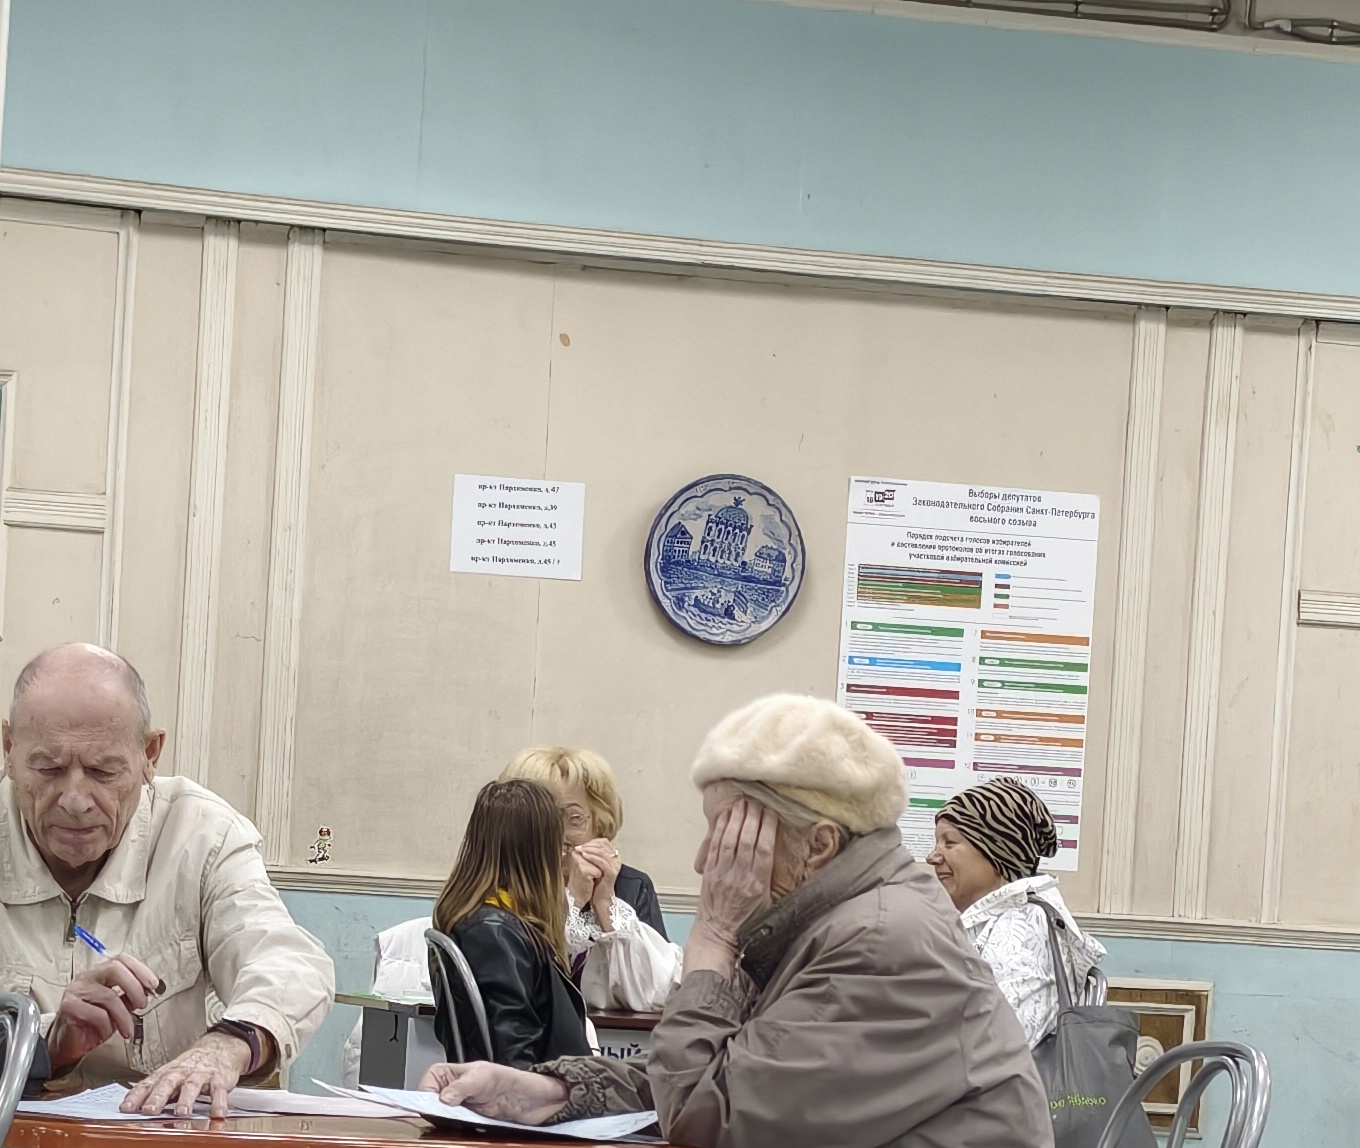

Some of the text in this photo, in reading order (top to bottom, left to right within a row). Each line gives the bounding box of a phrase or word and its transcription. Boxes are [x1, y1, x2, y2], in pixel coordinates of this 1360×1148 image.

[968, 488, 1000, 502] Выборы
[912, 496, 1096, 521] Законодательного Собрания Санкт-Петербурга
